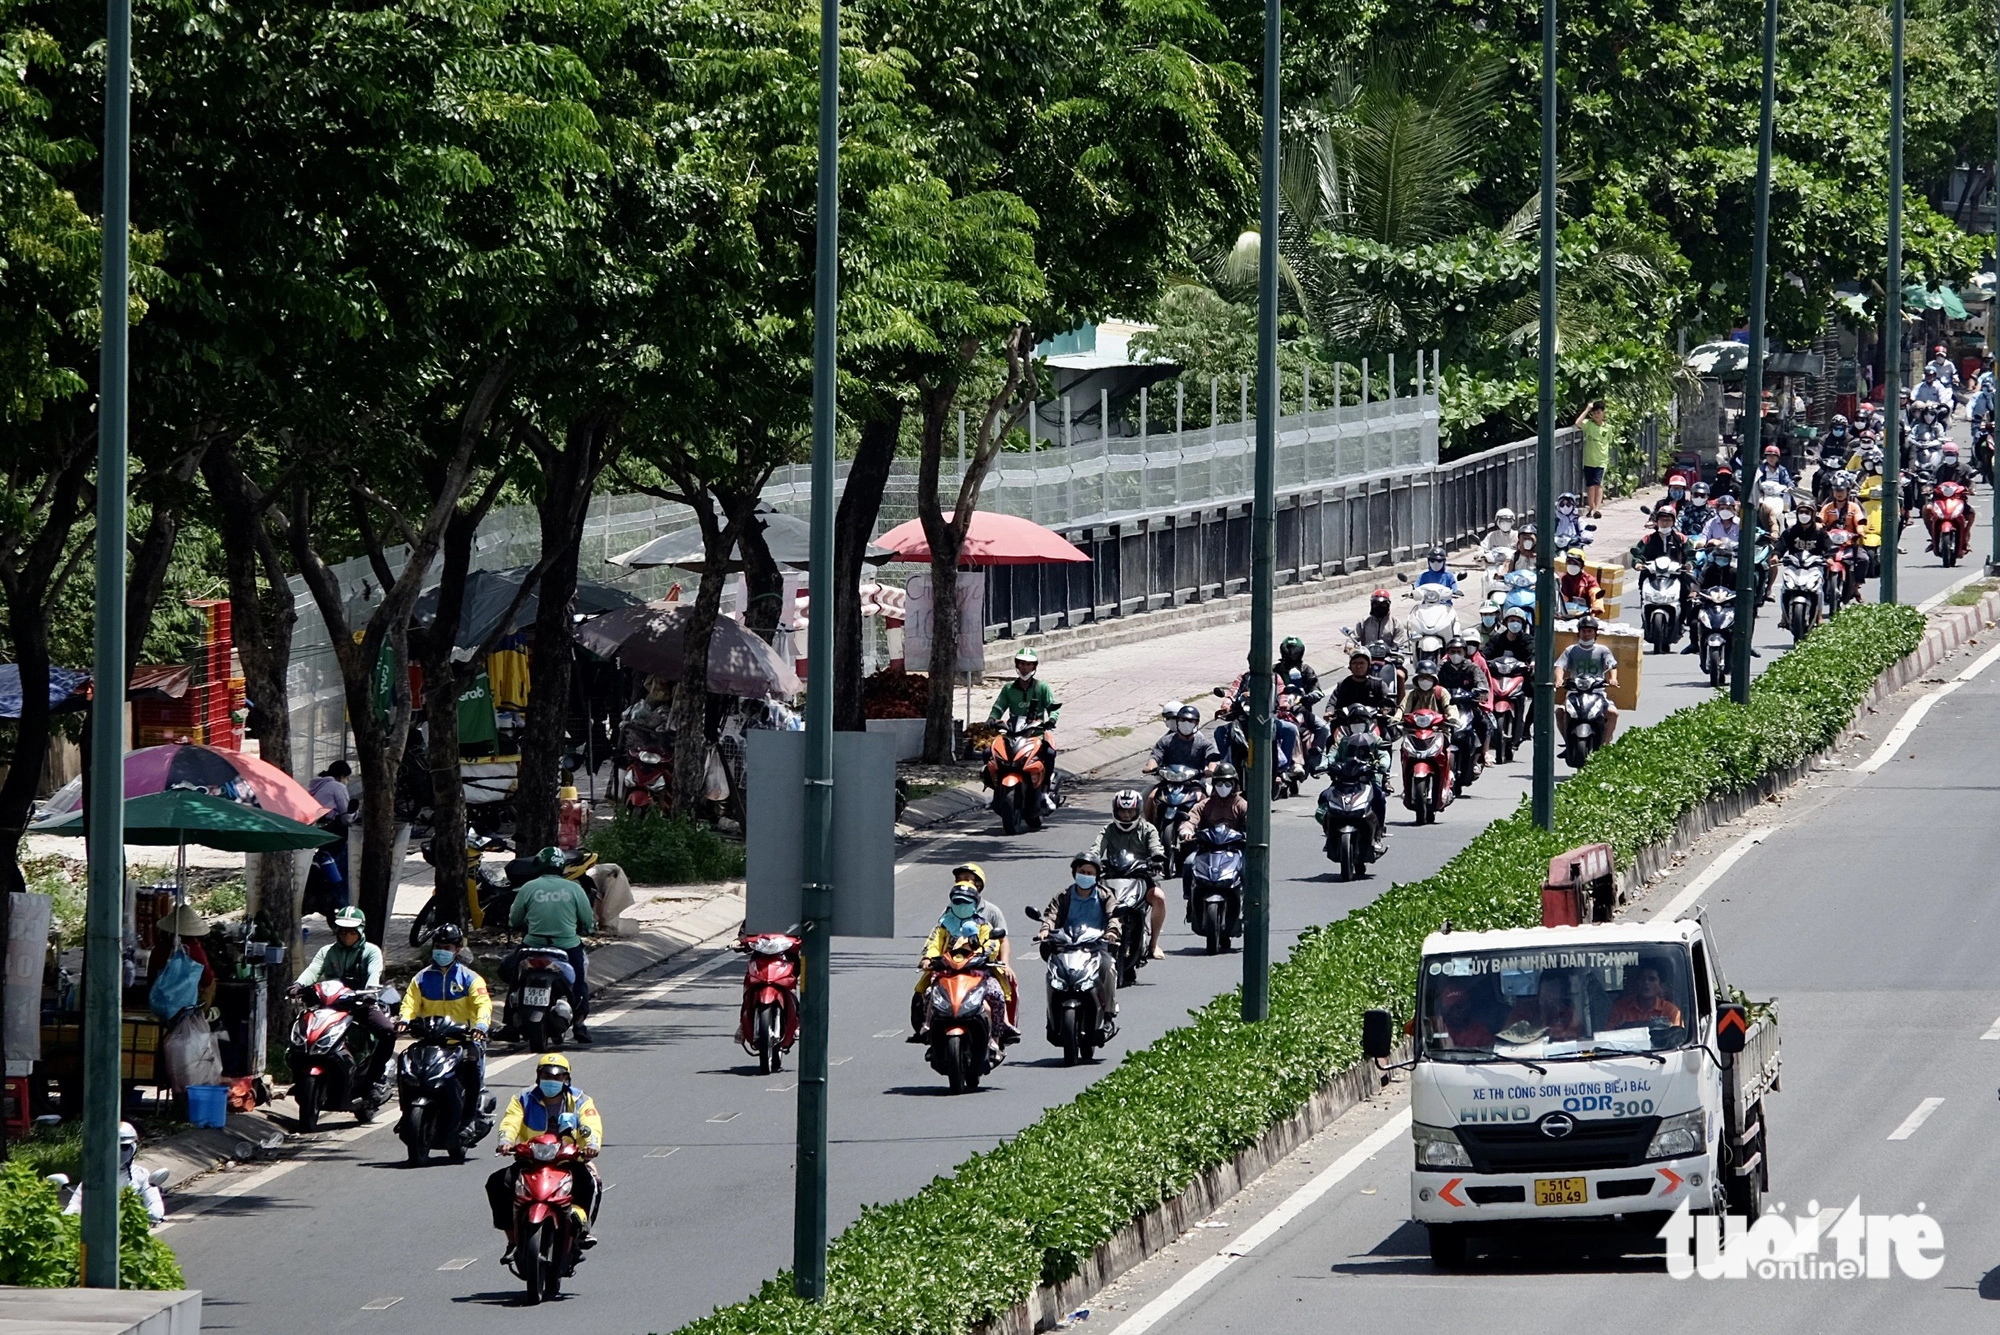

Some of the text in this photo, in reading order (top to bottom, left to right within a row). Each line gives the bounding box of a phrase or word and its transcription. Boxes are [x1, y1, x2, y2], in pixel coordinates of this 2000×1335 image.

[534, 888, 571, 903] Grab
[1491, 956, 1518, 973] BAN
[1521, 952, 1558, 970] NHÂN
[1560, 950, 1586, 968] DÂN
[1473, 1088, 1486, 1100] XE
[1507, 1085, 1536, 1099] CÔNG
[1539, 1084, 1561, 1097] SƠN
[1460, 1105, 1531, 1122] HINO
[1562, 1095, 1654, 1117] QDR 300
[1549, 1179, 1571, 1191] 51C
[1541, 1191, 1581, 1204] 308.49
